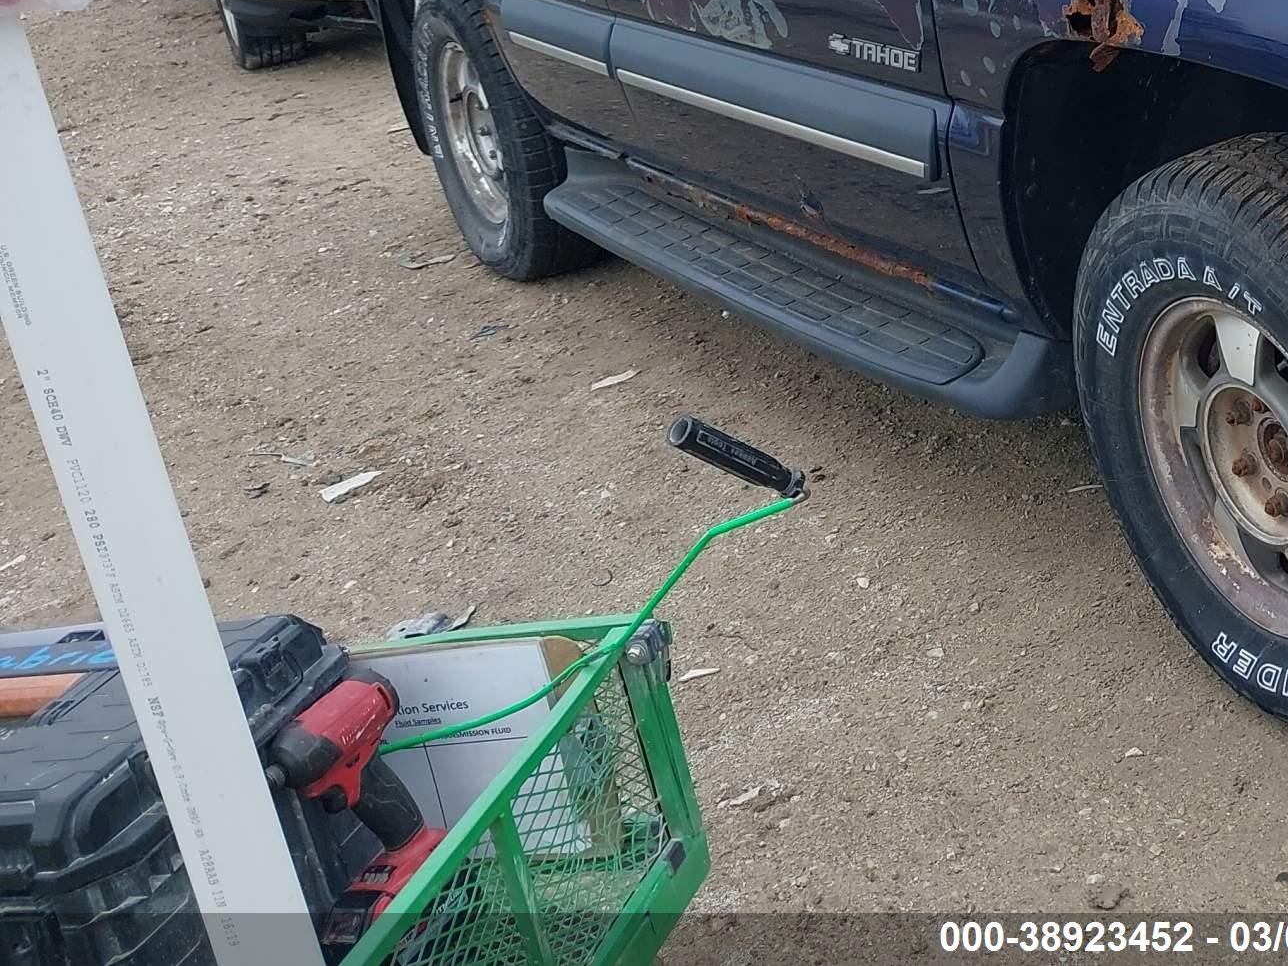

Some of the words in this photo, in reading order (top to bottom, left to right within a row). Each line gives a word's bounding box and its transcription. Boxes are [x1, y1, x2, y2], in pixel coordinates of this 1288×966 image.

[852, 38, 918, 72] TAHOE
[1096, 256, 1197, 357] ENTRADA
[55, 424, 72, 448] DWV
[83, 508, 101, 529] 280
[421, 699, 469, 714] Services
[394, 720, 412, 728] Fluid
[412, 717, 442, 726] Samples
[491, 727, 512, 736] FLUID
